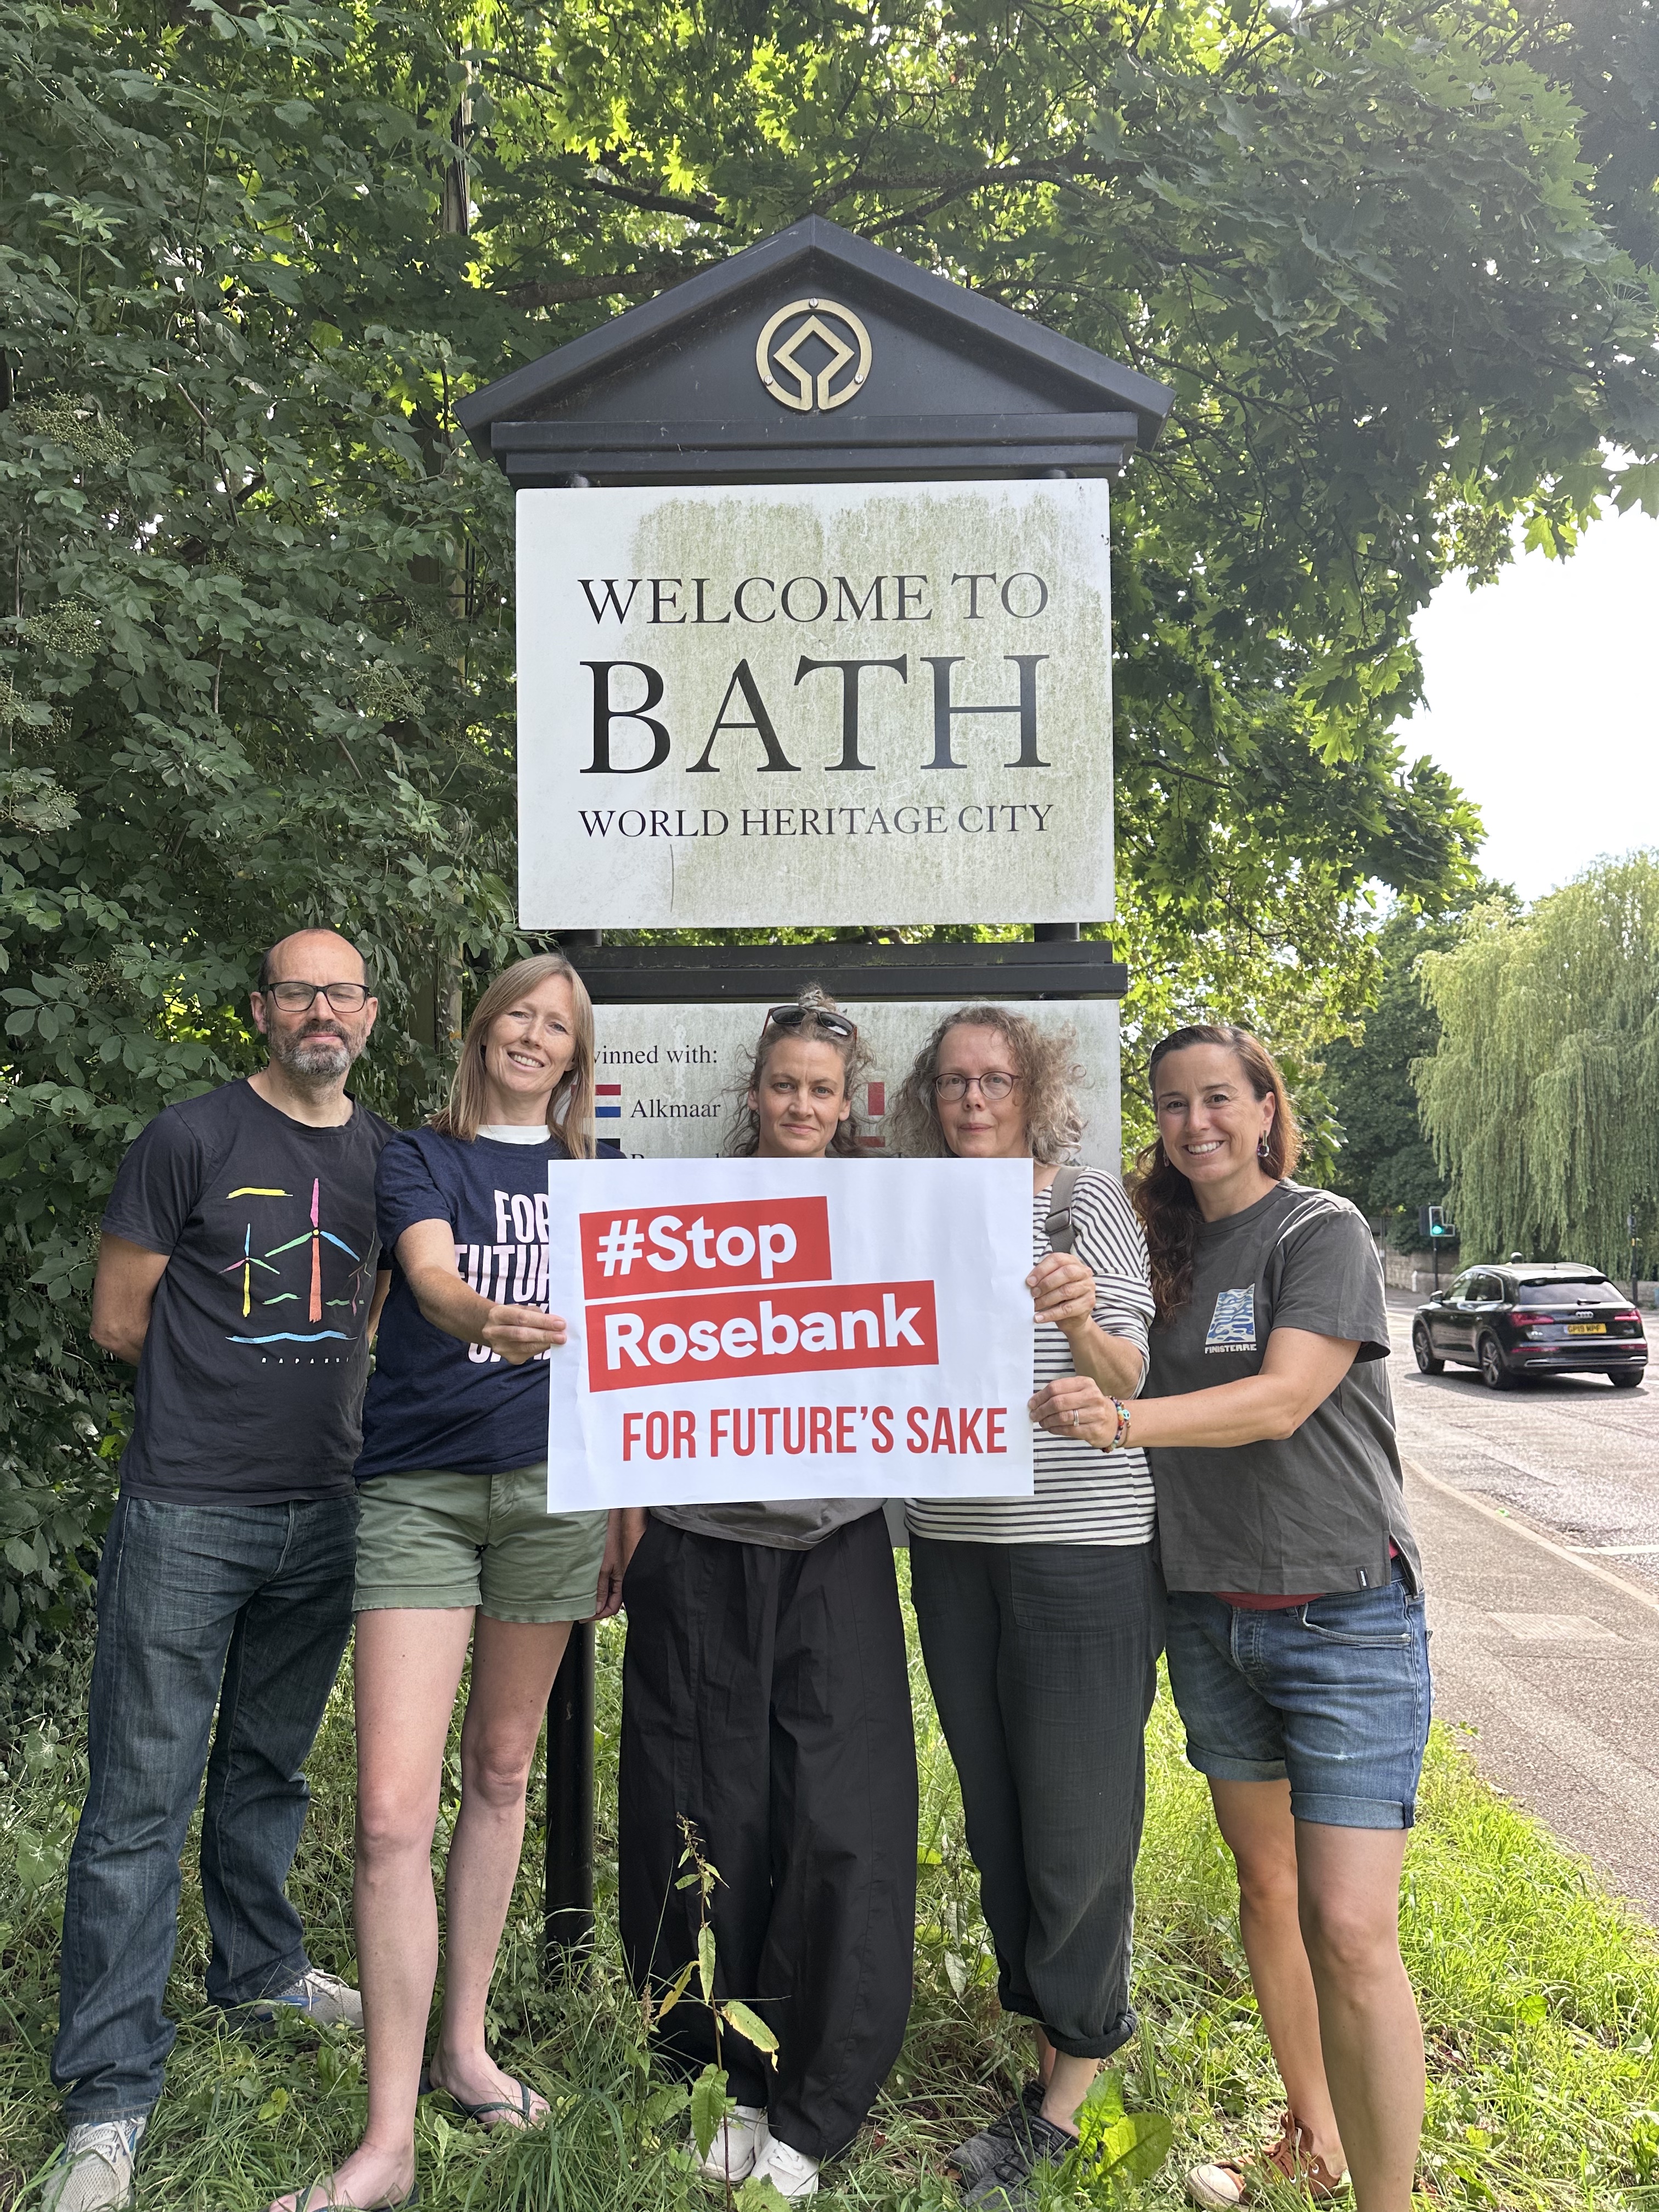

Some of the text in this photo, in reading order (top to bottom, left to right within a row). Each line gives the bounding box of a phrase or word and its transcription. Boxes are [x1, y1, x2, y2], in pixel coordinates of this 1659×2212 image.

[577, 572, 1049, 625] WELCOME TO
[579, 653, 1051, 774] BATH
[578, 804, 1054, 837] WORLD HERITAGE CITY
[667, 1045, 717, 1064] with:
[630, 1099, 721, 1119] Alkmaar
[596, 1215, 797, 1279] #Stop
[605, 1293, 926, 1371] Rosebank
[1204, 1344, 1257, 1354] FINISTERRE
[623, 1410, 696, 1461] FOR
[907, 1406, 1008, 1454] SAKE
